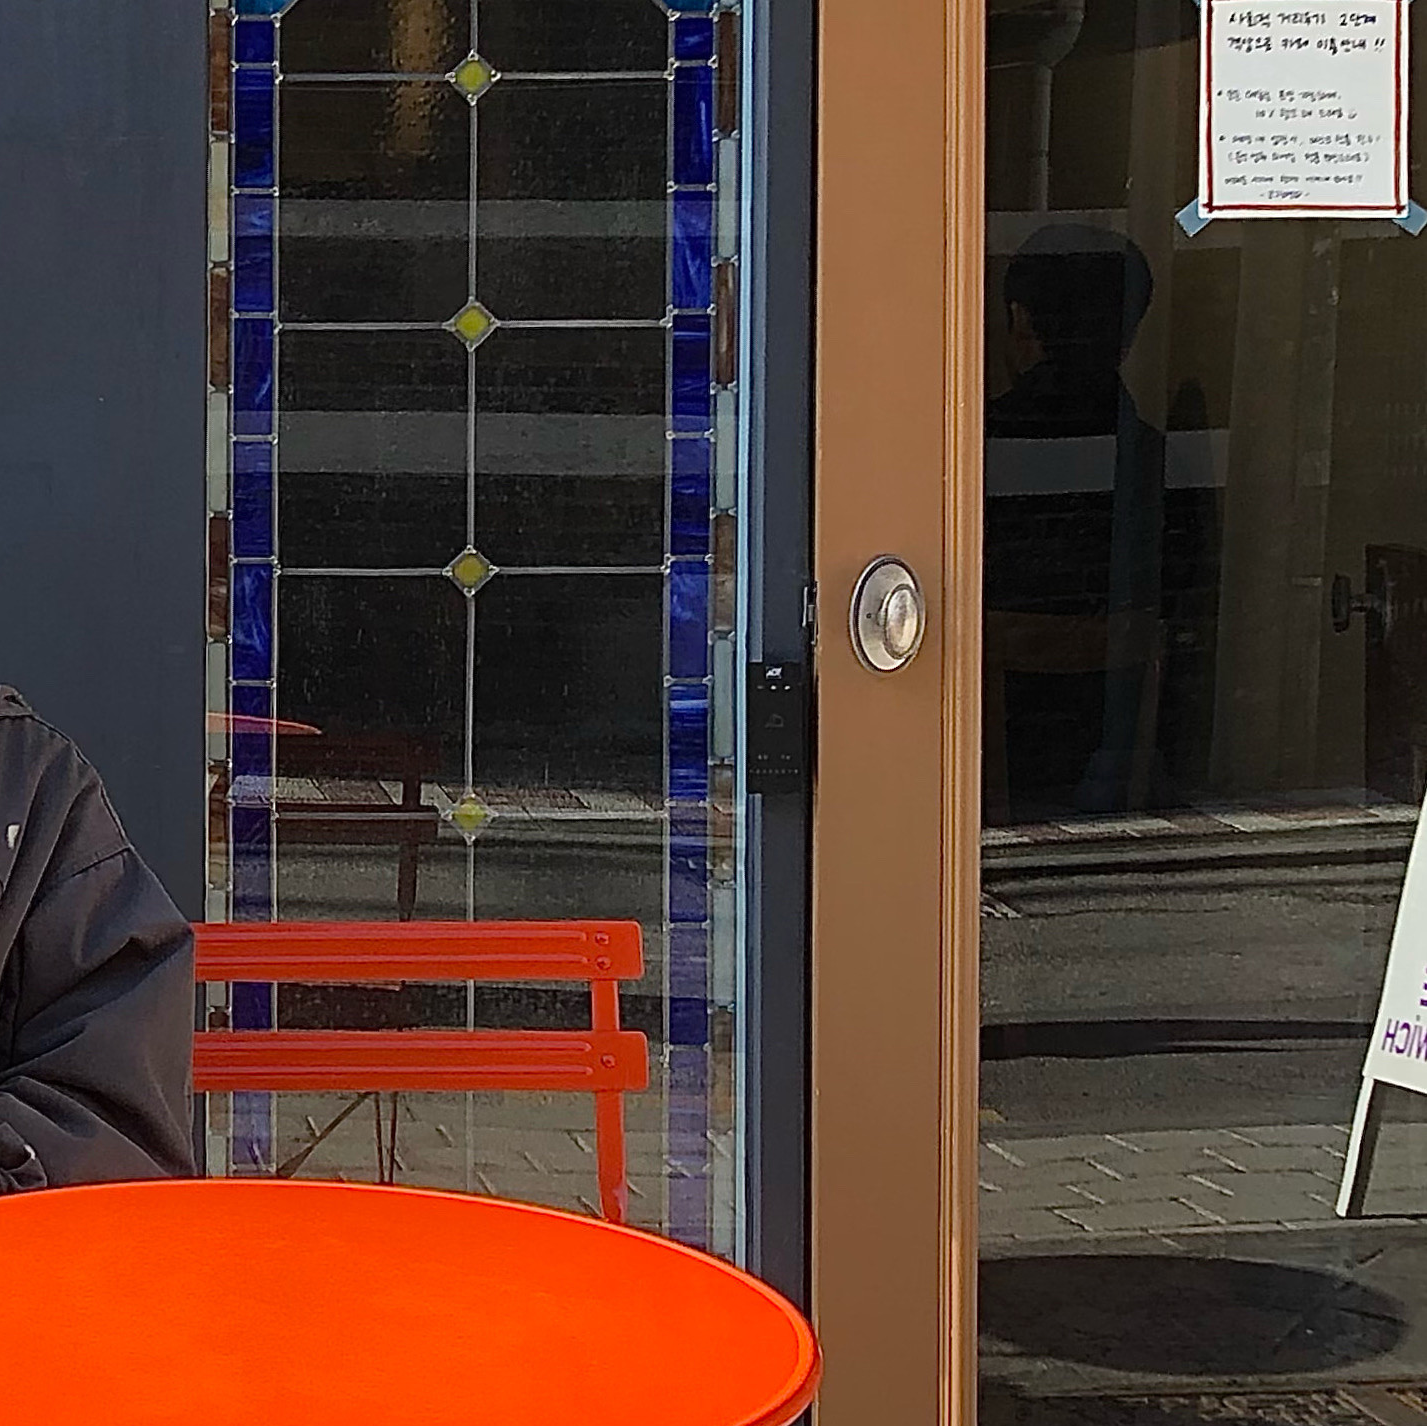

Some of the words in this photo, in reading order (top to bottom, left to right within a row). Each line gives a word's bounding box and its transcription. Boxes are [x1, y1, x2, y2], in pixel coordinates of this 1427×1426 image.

[1228, 10, 1271, 28] 사회적
[1277, 10, 1326, 27] 거리두기
[1339, 12, 1378, 28] 2단계
